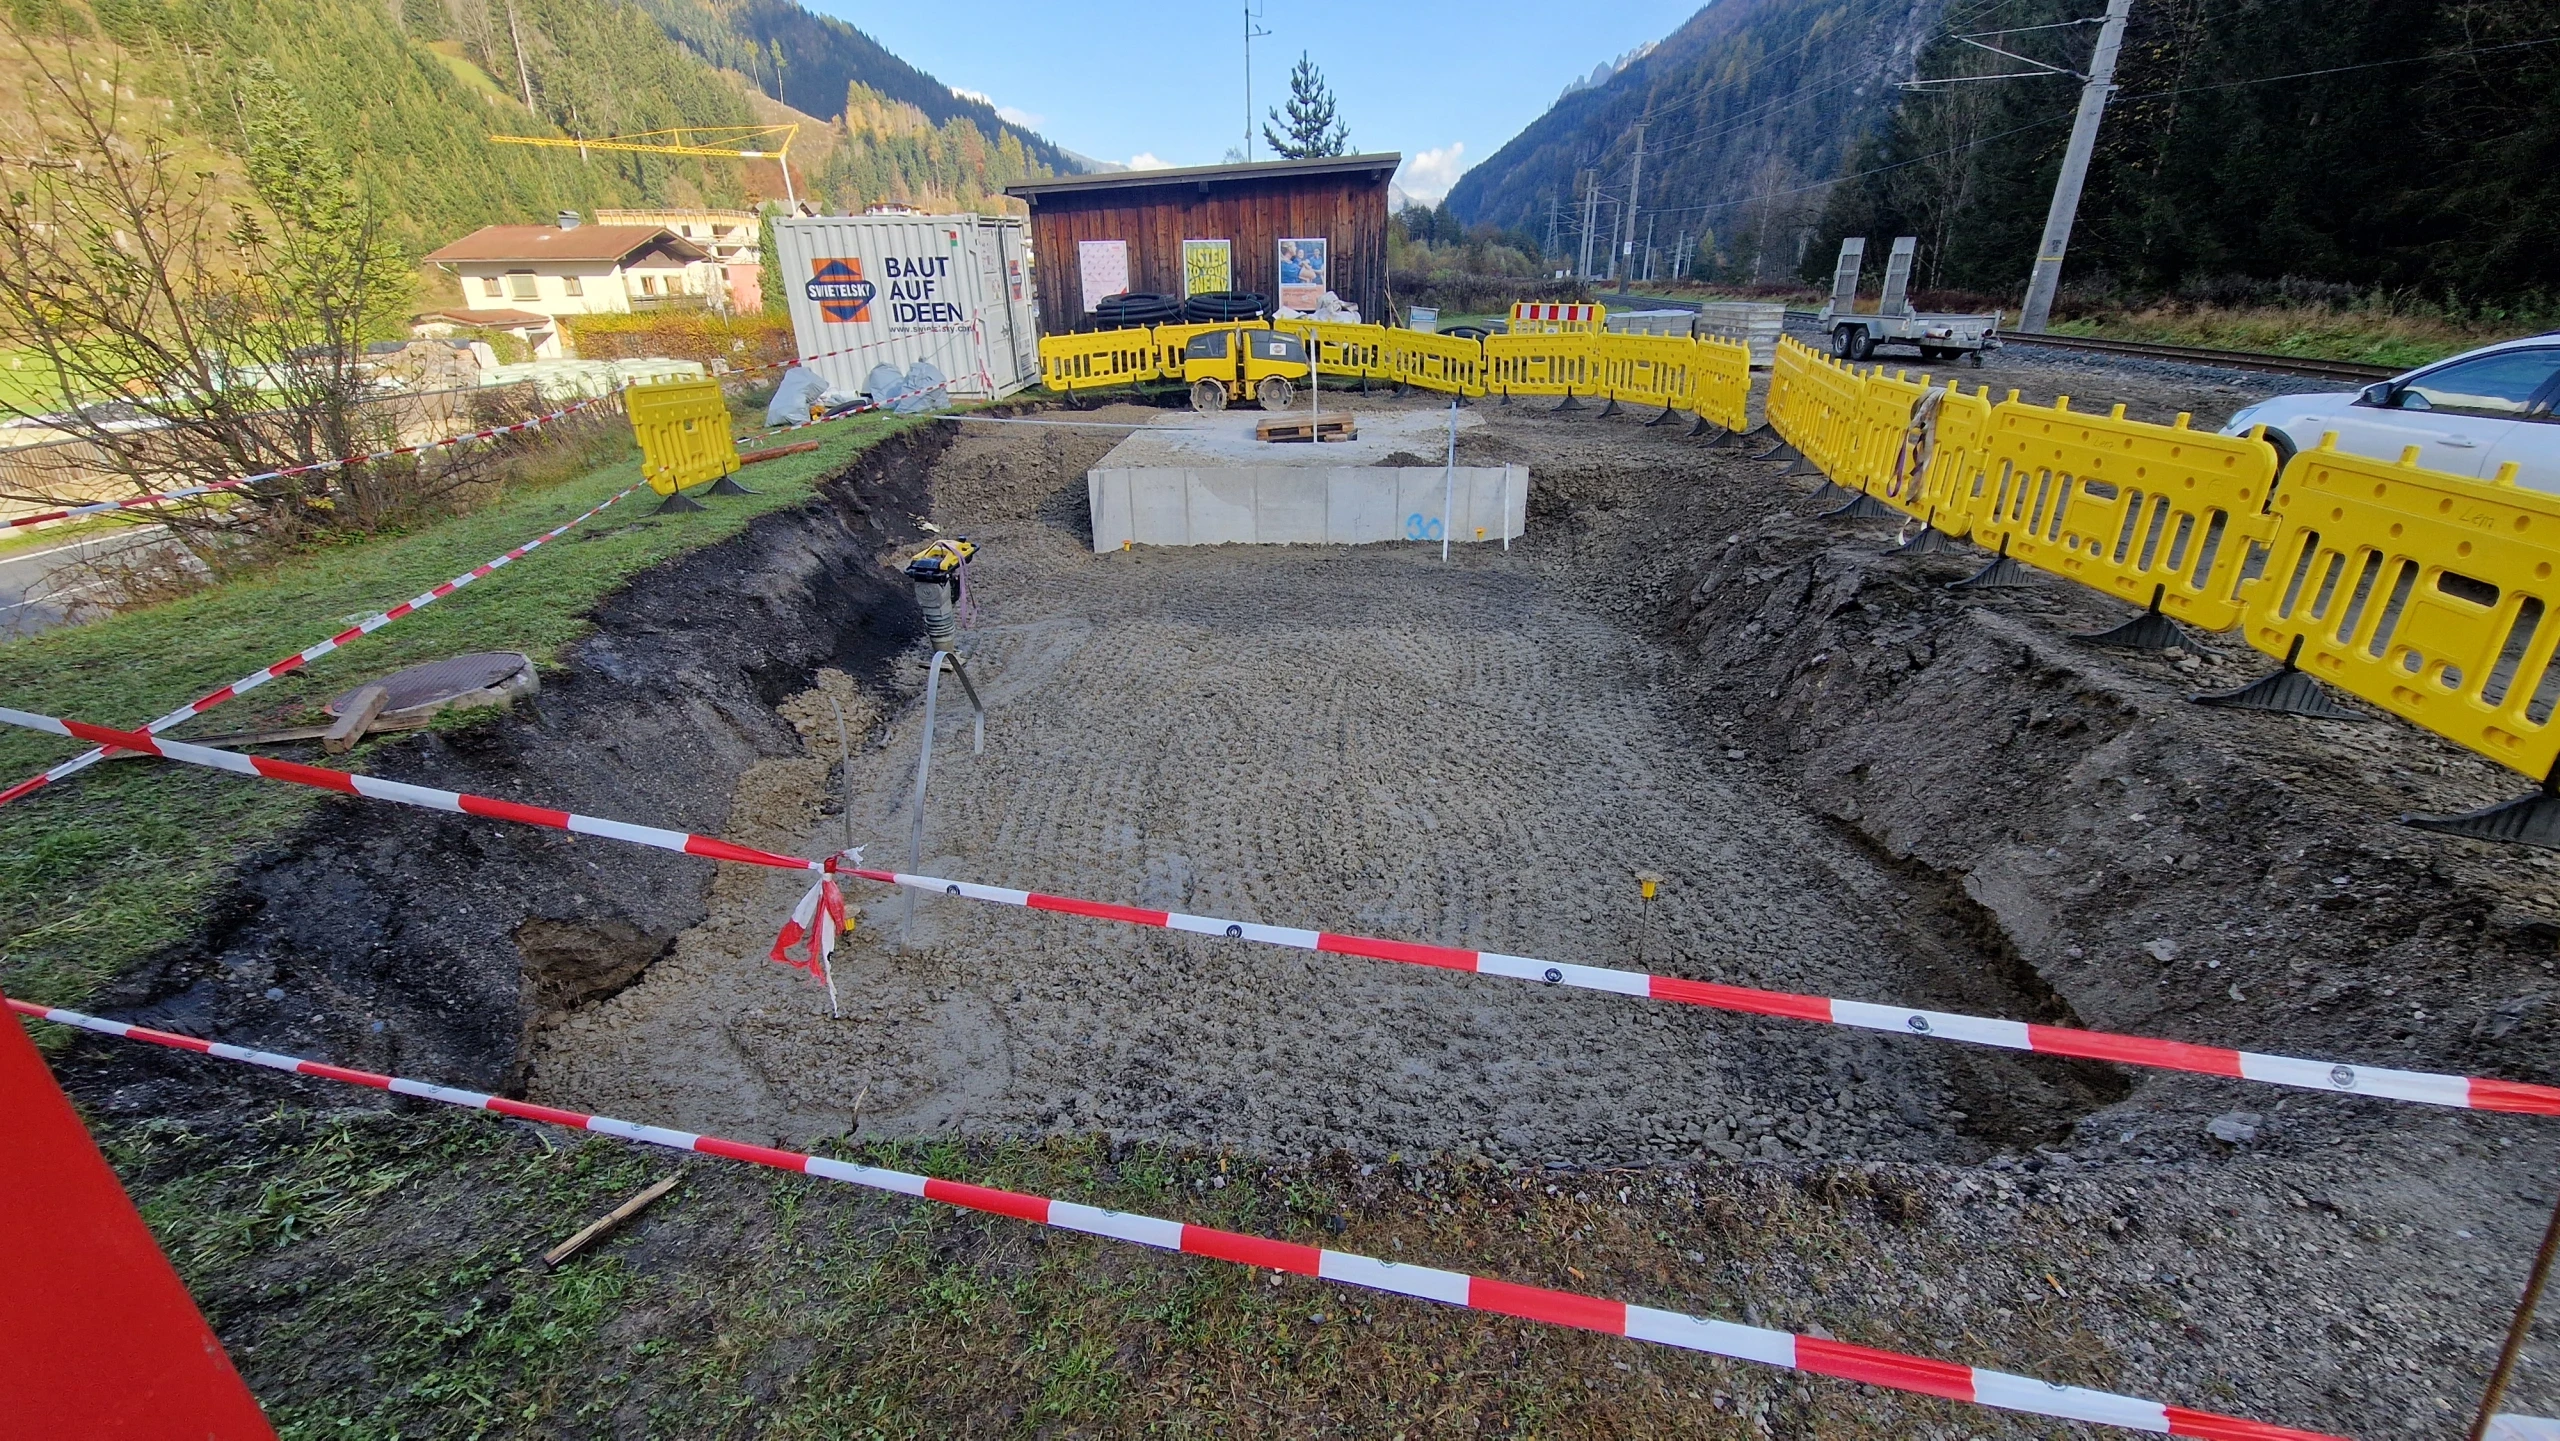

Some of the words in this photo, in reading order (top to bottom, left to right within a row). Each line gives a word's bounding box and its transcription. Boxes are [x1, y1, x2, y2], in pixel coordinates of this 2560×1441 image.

[885, 256, 949, 278] BAUT
[1187, 248, 1227, 268] LISTEN
[1187, 263, 1200, 278] TO
[1202, 264, 1228, 279] YOUR
[808, 284, 870, 298] SWIETELSKY
[889, 280, 935, 300] AUF
[1189, 275, 1228, 294] ENEMY
[892, 302, 964, 323] IDEEN
